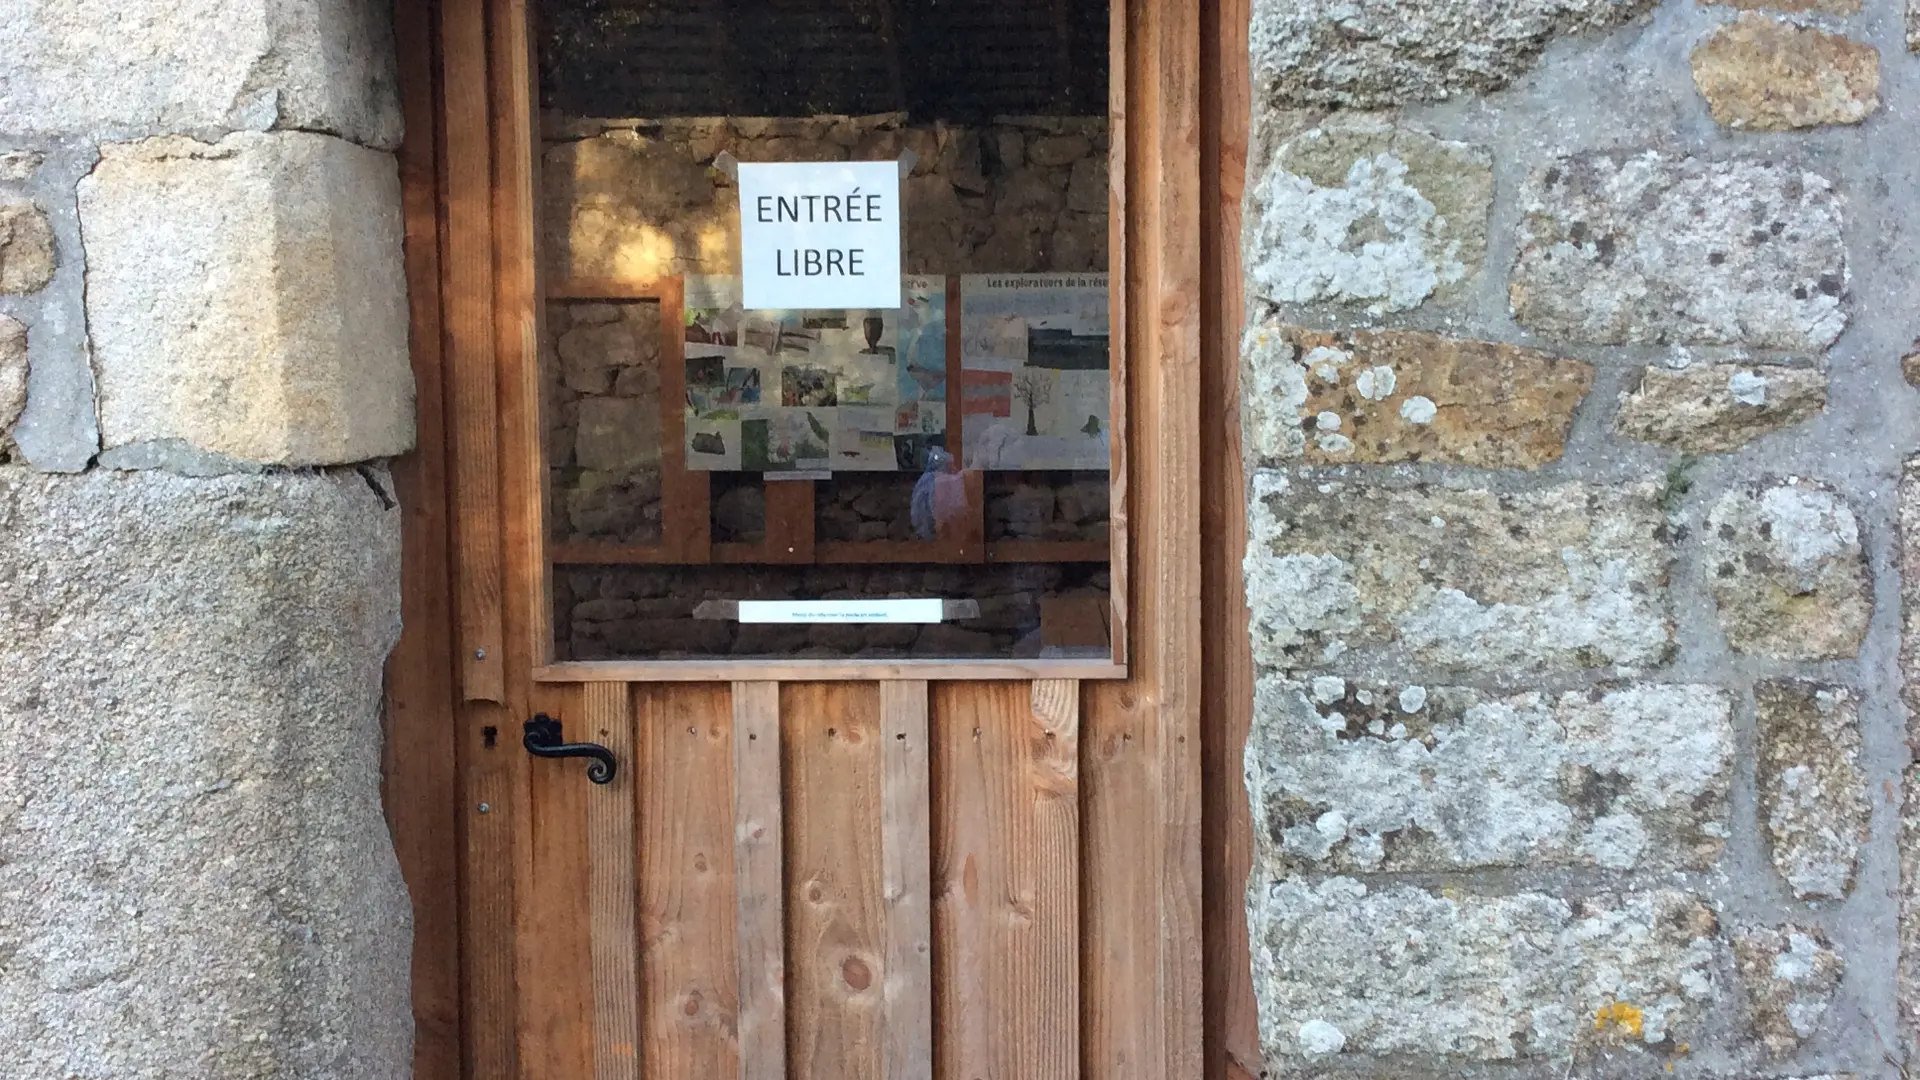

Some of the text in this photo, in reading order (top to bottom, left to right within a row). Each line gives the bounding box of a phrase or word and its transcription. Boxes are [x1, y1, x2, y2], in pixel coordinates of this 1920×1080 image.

[757, 187, 882, 222] ENTRÉE
[777, 249, 865, 276] LIBRE
[987, 277, 1003, 288] Les
[1004, 277, 1063, 290] explorateurs
[1065, 276, 1076, 288] de
[1077, 276, 1087, 288] la
